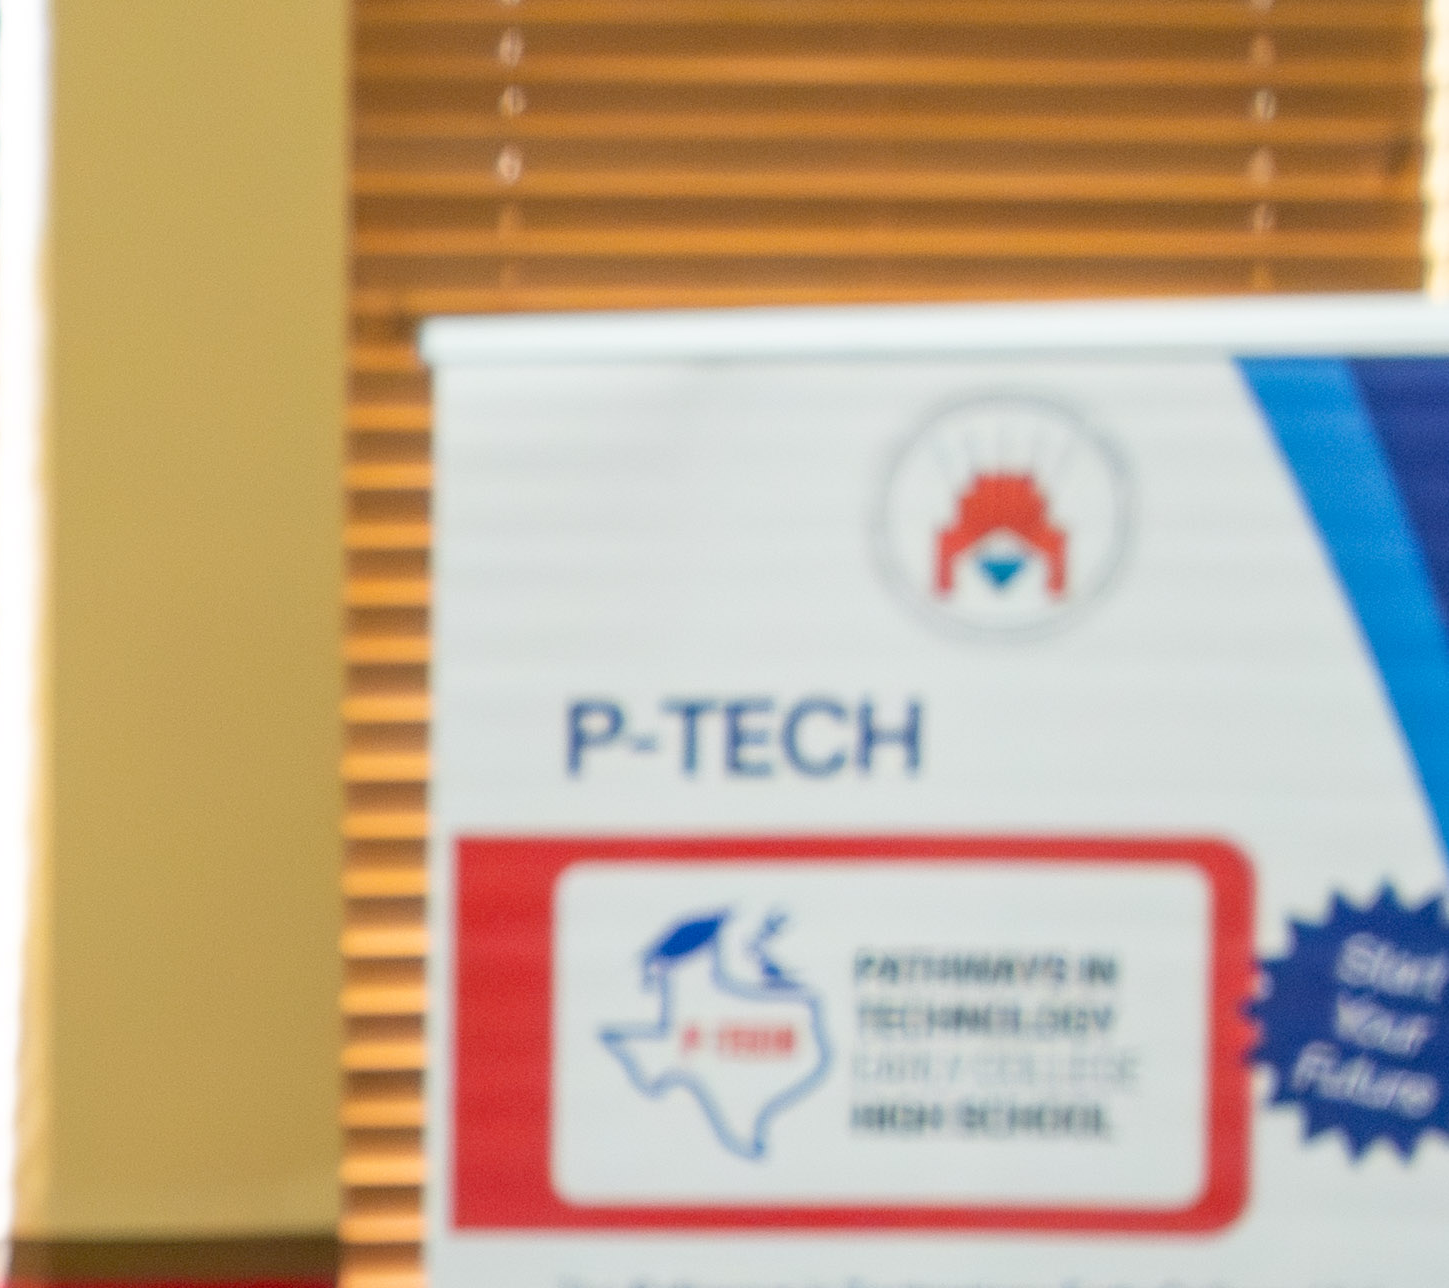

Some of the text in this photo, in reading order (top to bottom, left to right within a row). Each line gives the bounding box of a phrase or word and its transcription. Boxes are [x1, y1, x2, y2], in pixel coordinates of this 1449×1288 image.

[565, 697, 923, 779] P-TECH
[853, 953, 1067, 986] PATHWAYS
[1335, 934, 1447, 1001] Start
[855, 1002, 1115, 1036] TECHNOLOGY
[1292, 1043, 1438, 1119] Future
[954, 1102, 1110, 1136] SCHOOL
